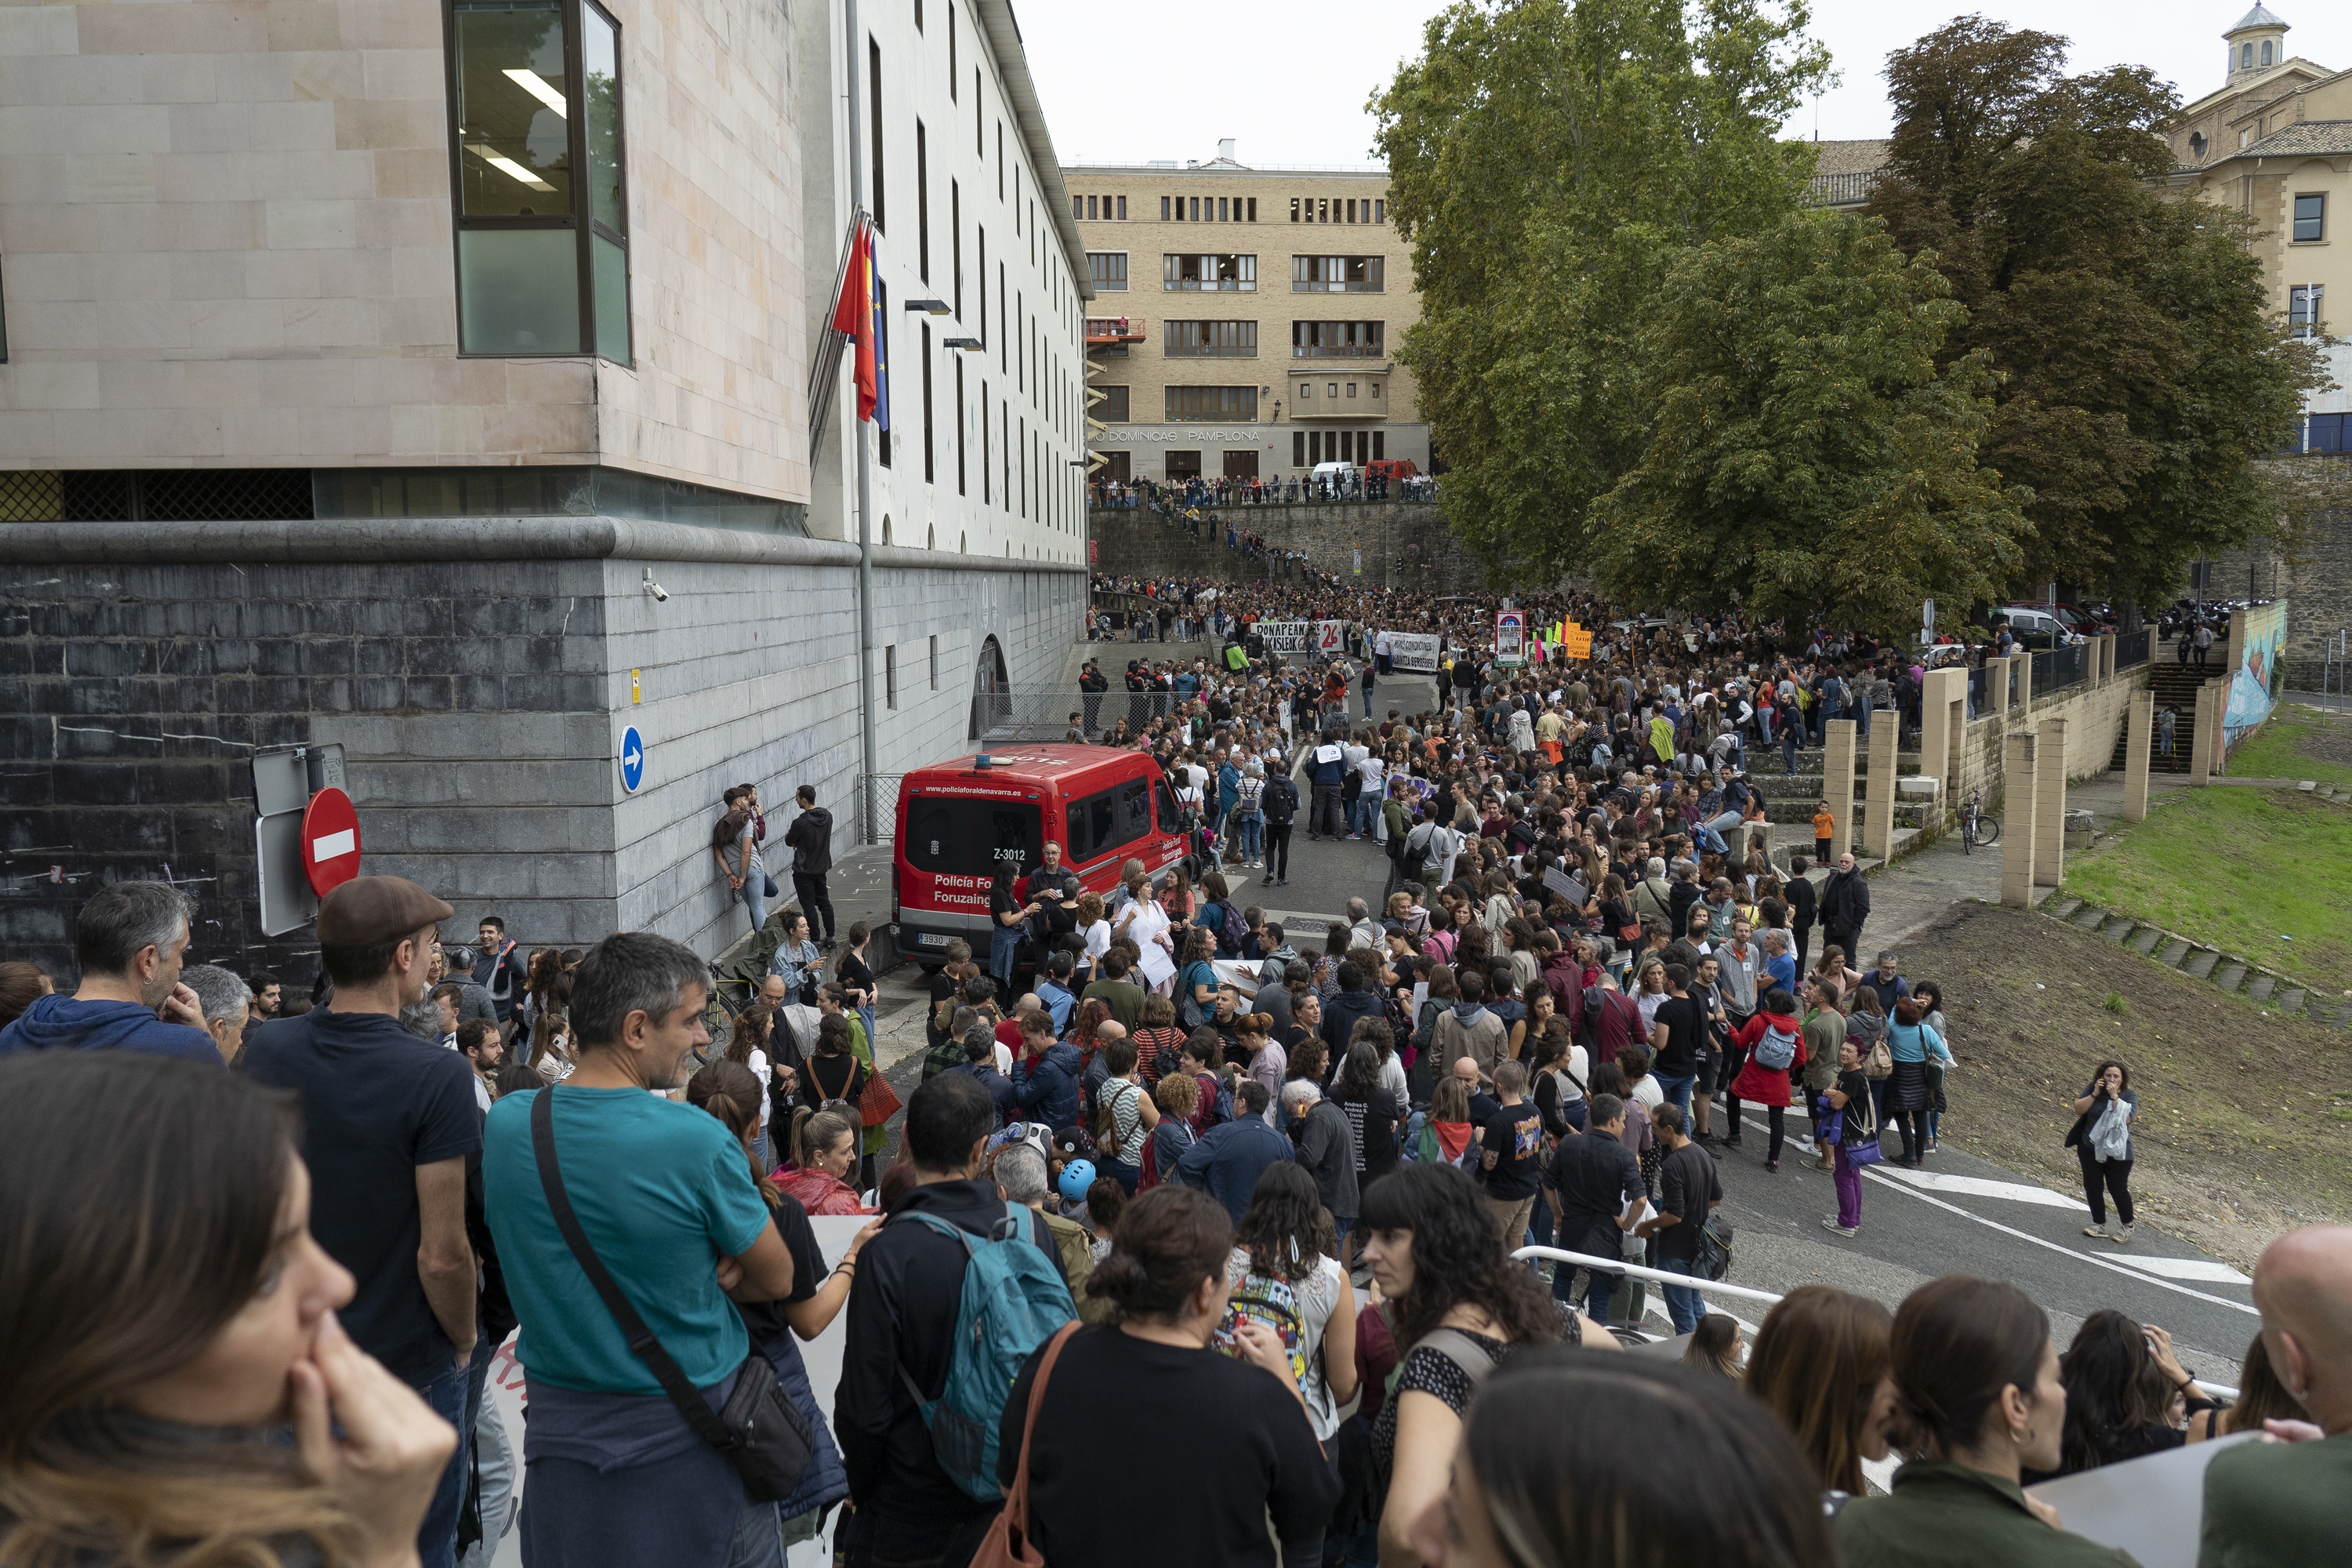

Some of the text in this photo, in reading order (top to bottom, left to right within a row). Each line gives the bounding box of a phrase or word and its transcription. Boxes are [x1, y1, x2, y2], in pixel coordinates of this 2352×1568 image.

[1109, 431, 1178, 442] DOMINICAS
[1188, 431, 1261, 442] PAMPLONA
[925, 786, 1022, 797] www.policiaforaldenavarra.es
[993, 848, 1025, 861] Z-3012
[935, 874, 993, 889] Policía Fo
[924, 935, 944, 945] 3930
